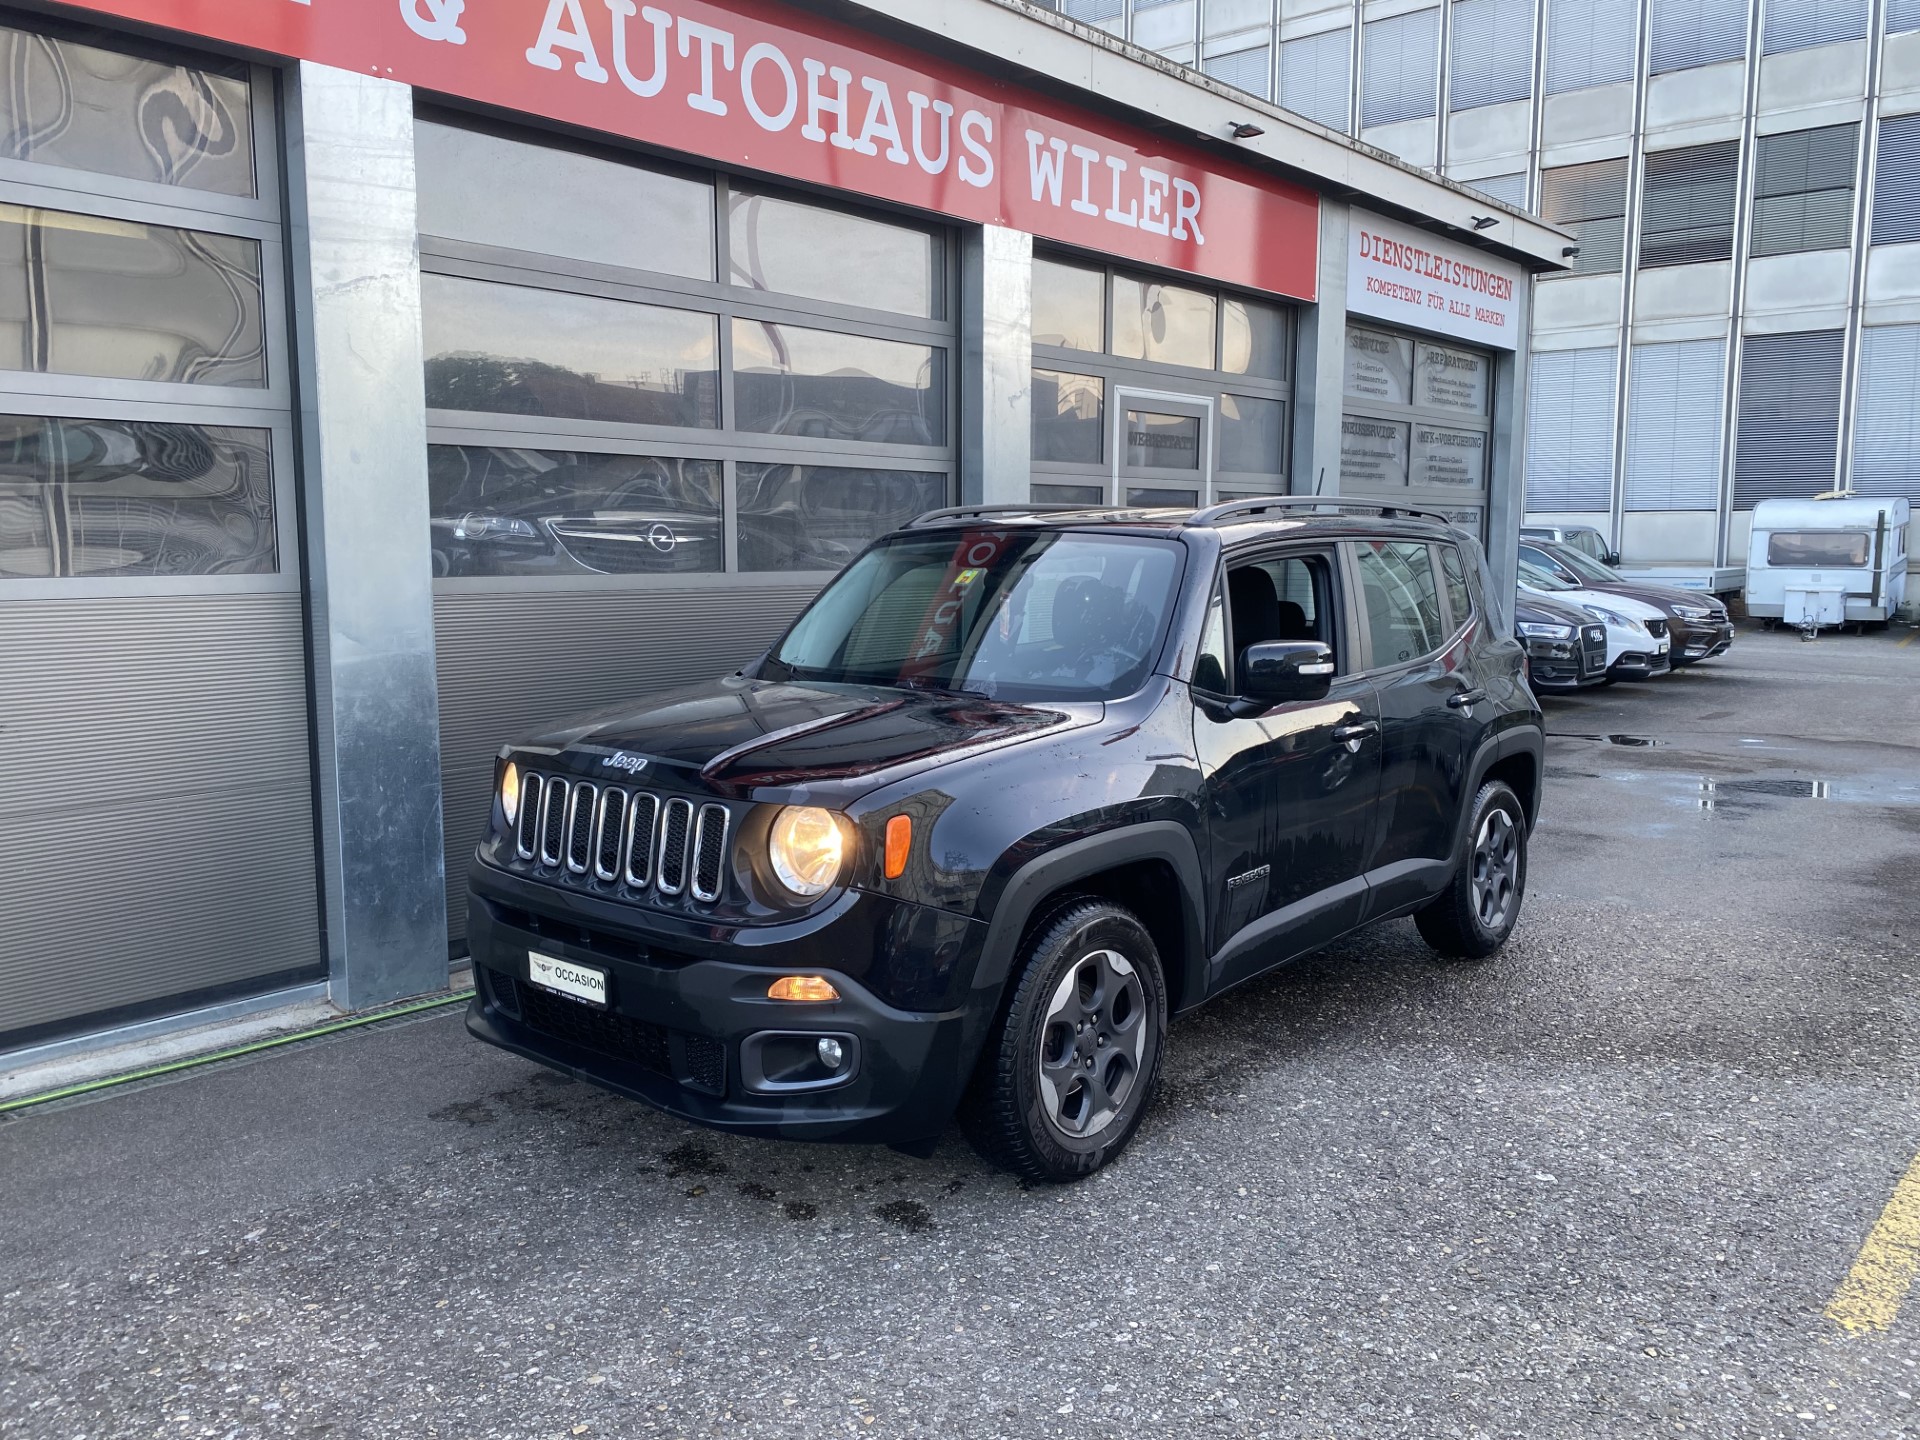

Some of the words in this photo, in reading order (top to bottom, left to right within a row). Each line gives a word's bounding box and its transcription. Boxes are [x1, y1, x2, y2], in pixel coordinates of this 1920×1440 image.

[525, 0, 995, 188] AUTOHAUS
[1025, 128, 1206, 246] WILER
[1359, 231, 1513, 302] DIENSTLEISTUNGEN
[1366, 276, 1421, 305] KOMPETENZ
[1427, 291, 1444, 310] FÜR
[1449, 299, 1470, 318] ALLE
[1474, 306, 1505, 327] MARKEN
[1430, 351, 1478, 372] REPARATUREN
[602, 751, 647, 774] Jeep
[555, 966, 603, 991] OCCASION
